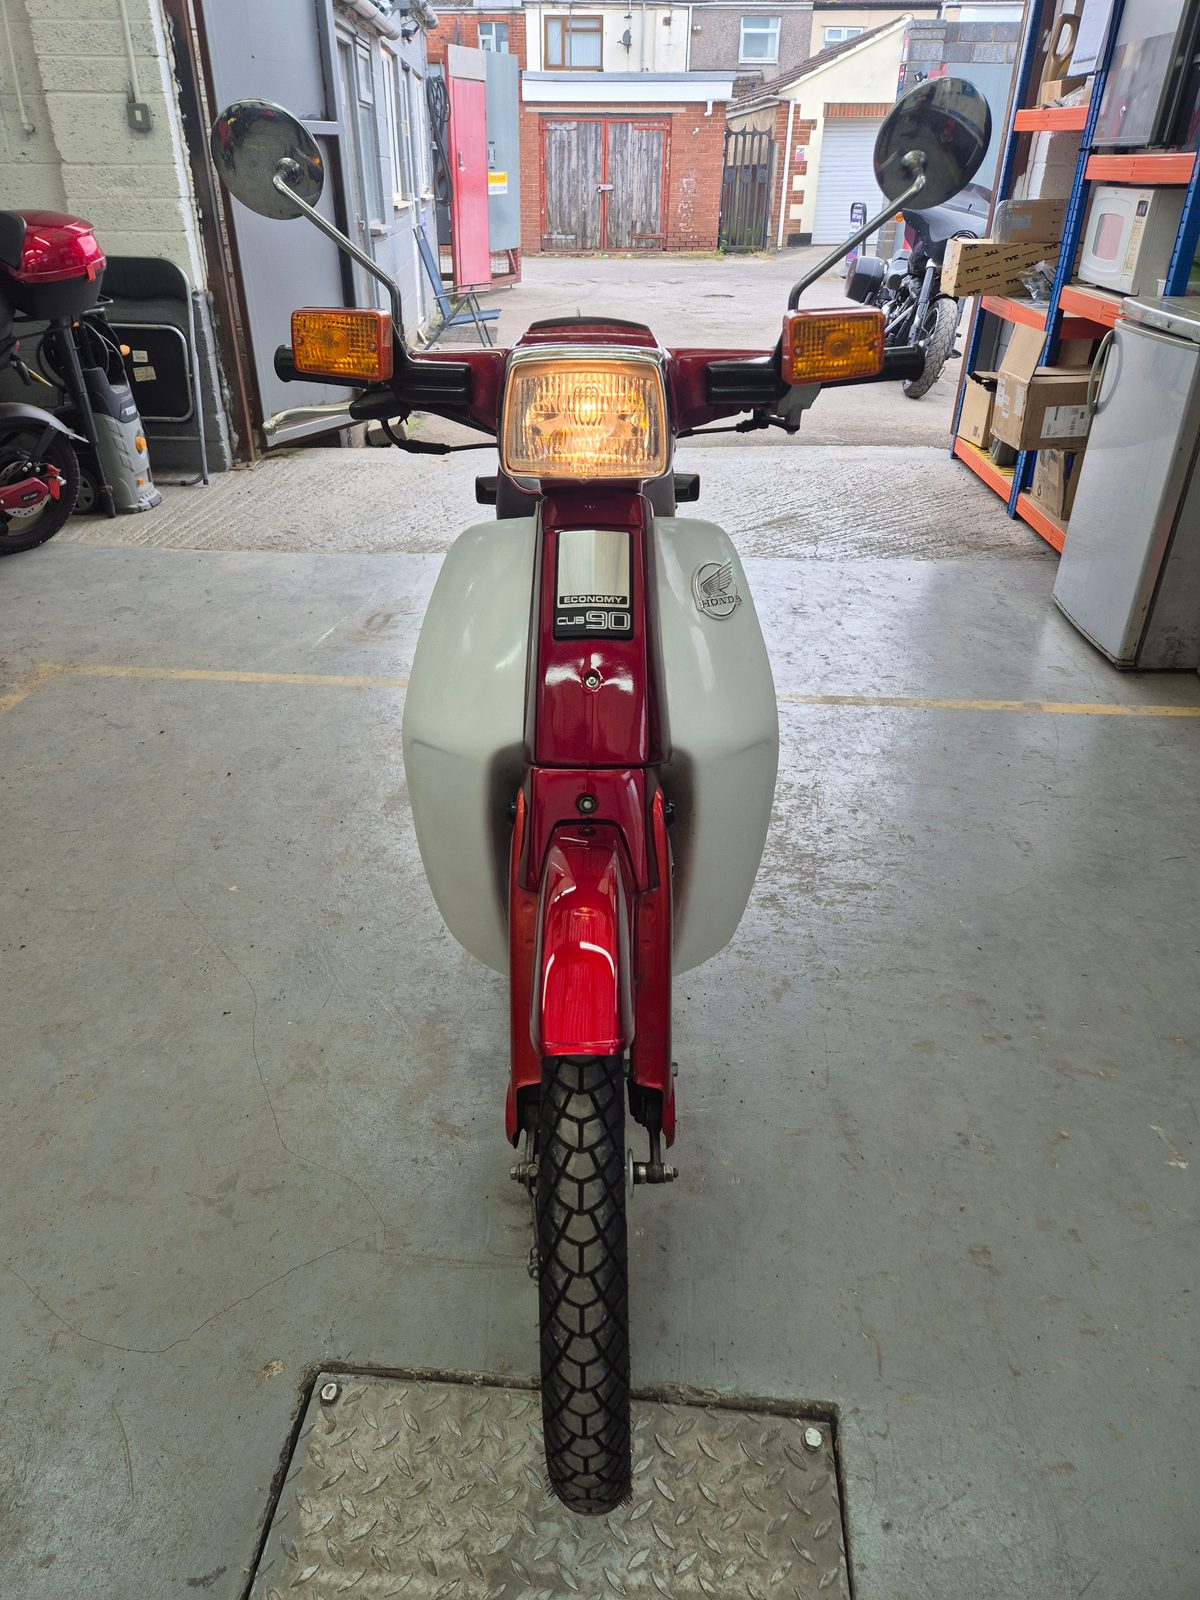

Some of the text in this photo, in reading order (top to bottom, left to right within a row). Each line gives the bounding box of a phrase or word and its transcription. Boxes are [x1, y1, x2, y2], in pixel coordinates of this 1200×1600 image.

[563, 595, 623, 603] ECONOMY
[700, 594, 743, 608] HONDA
[556, 610, 631, 631] CUB 90
